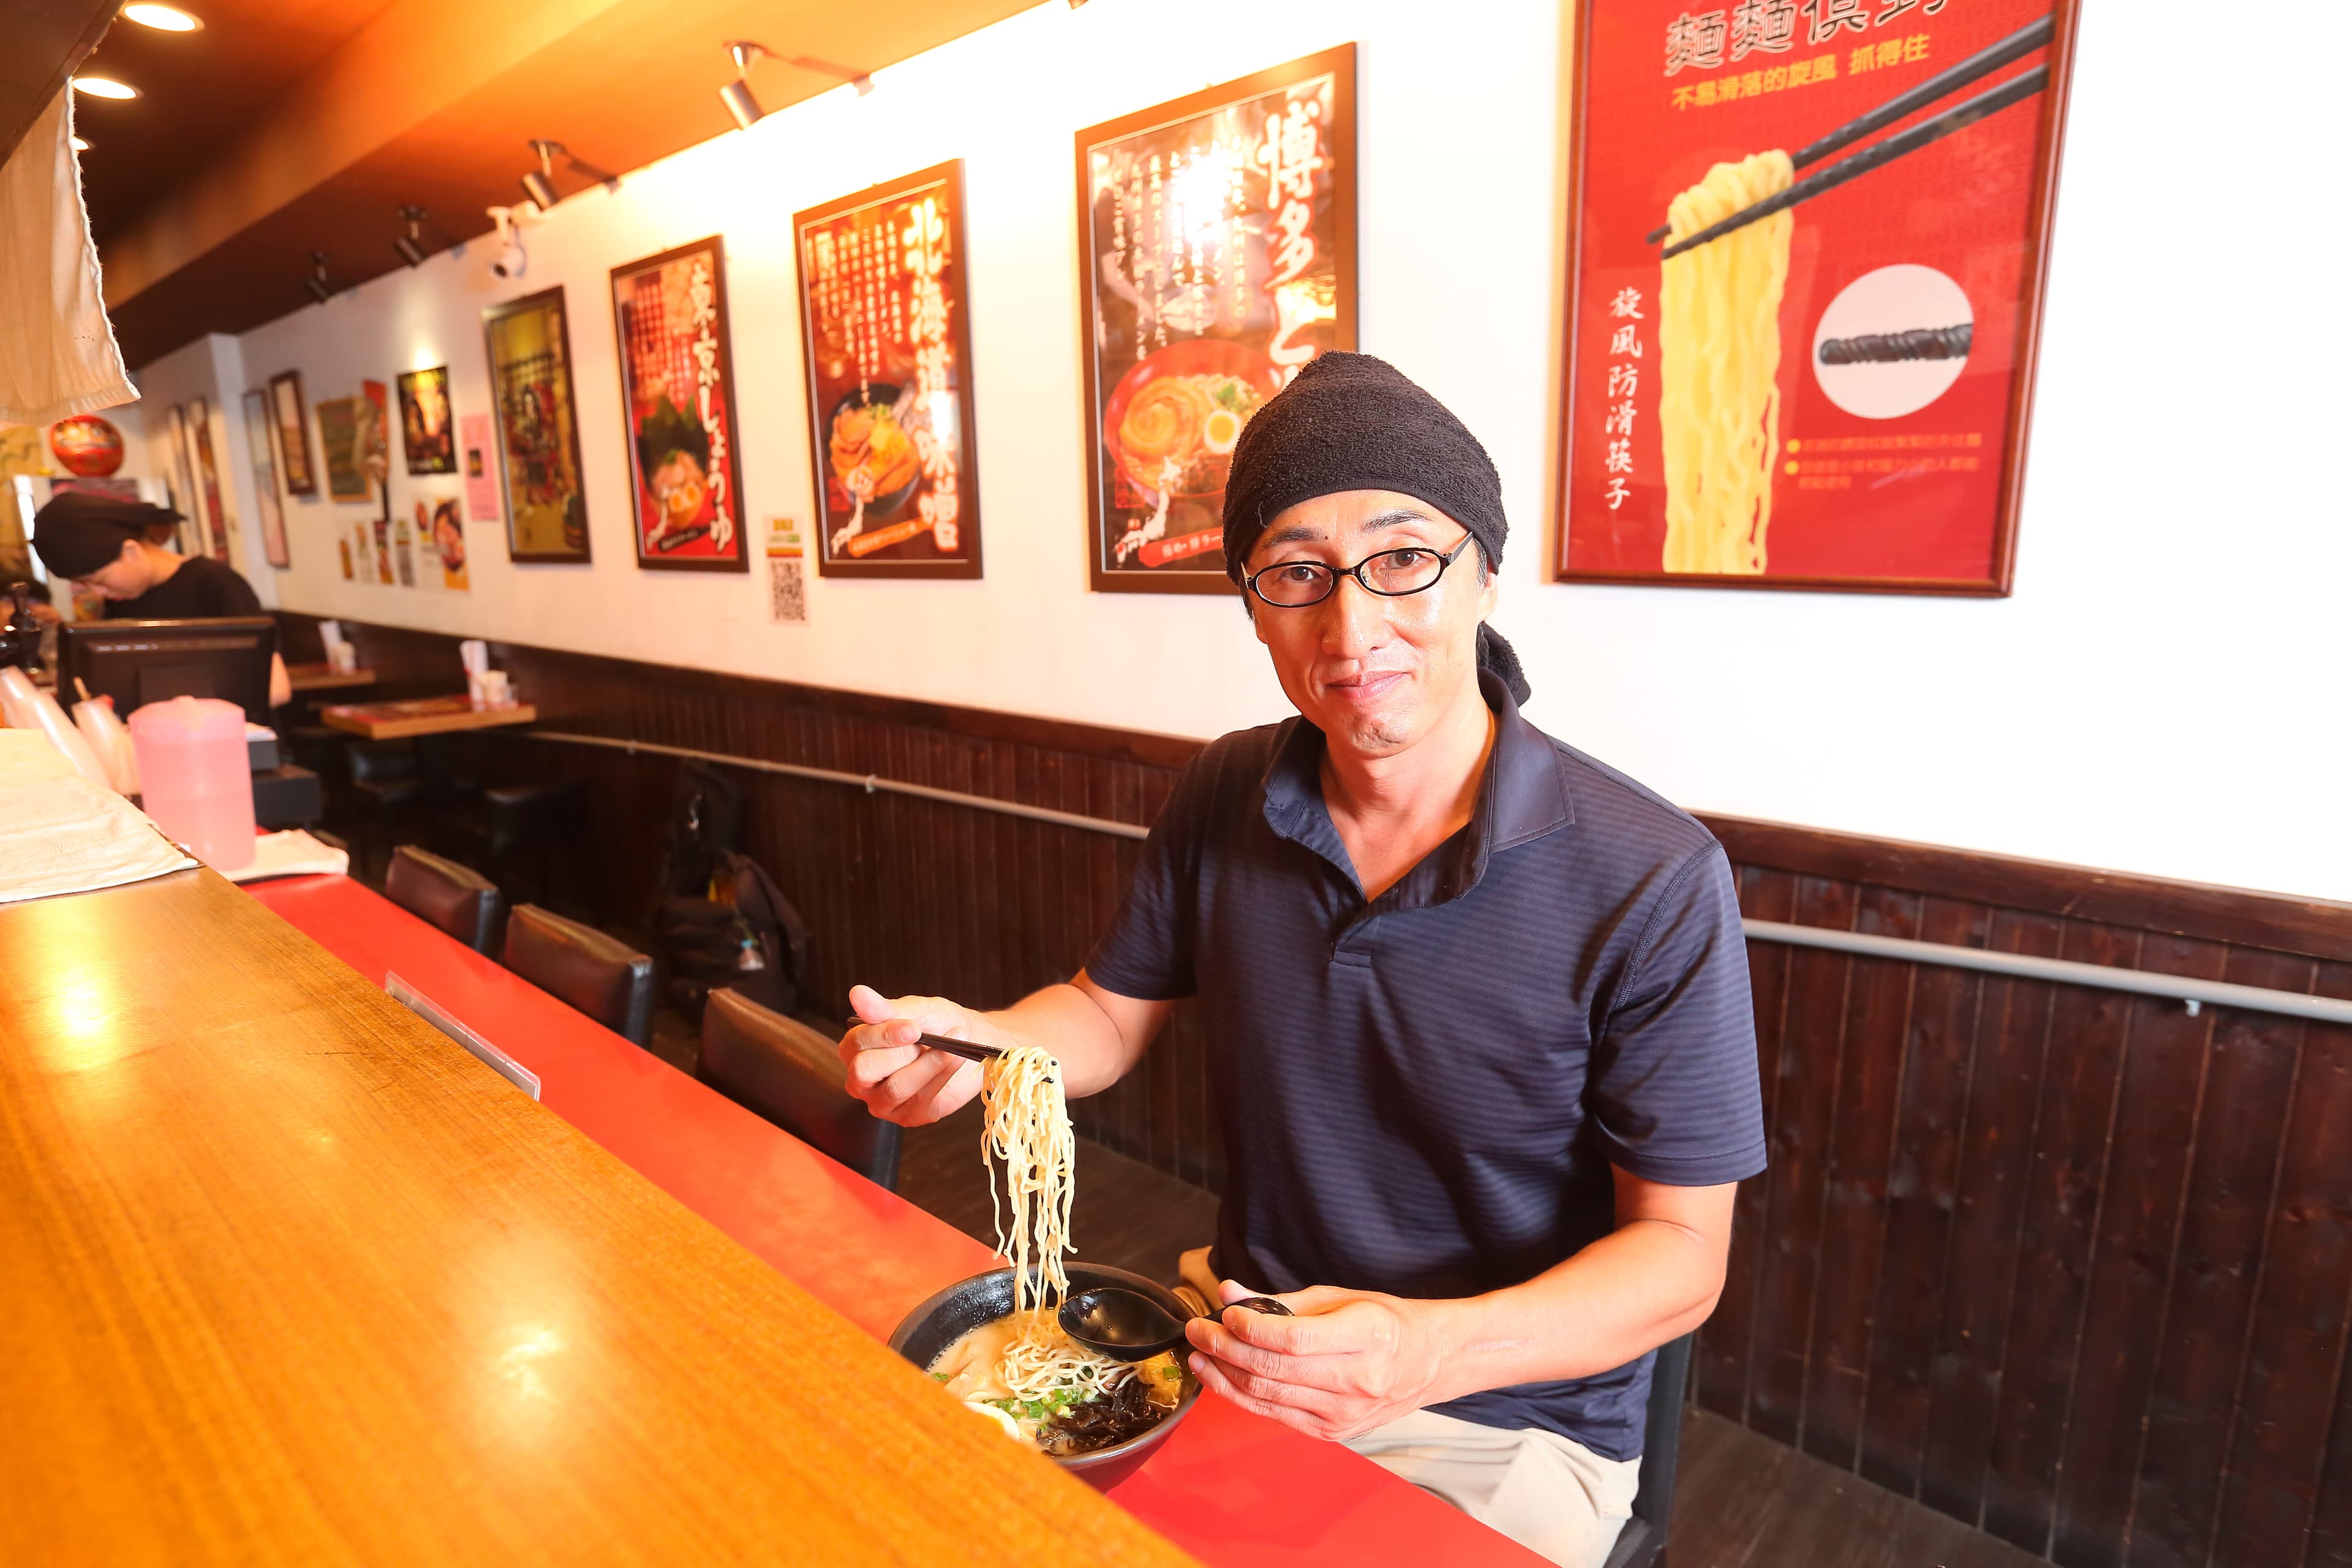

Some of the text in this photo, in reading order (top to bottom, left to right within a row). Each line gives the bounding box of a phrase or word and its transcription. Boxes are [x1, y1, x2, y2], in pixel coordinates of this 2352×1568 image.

[1671, 34, 1931, 111] 不易滑落的旋風 抓得住
[1604, 285, 1645, 510] 旋風防滑筷子
